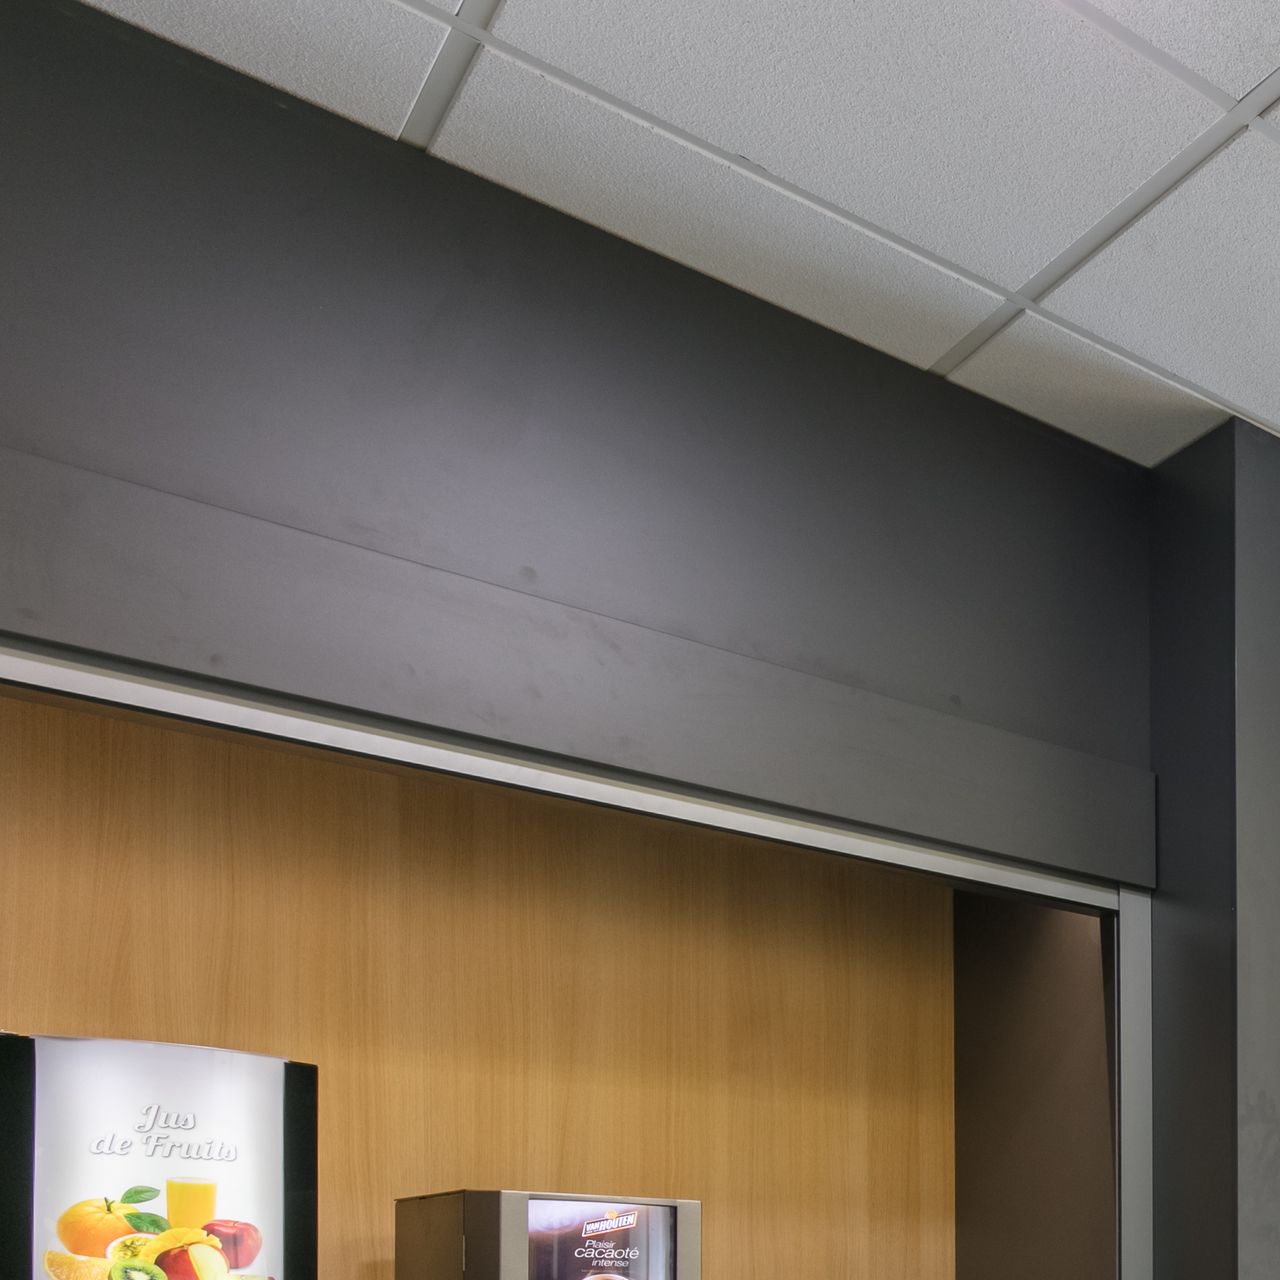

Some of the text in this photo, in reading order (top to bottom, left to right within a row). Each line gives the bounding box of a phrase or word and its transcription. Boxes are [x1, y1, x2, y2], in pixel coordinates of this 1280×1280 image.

[135, 1104, 196, 1133] Jus
[90, 1133, 238, 1161] de Fruits
[585, 1239, 616, 1249] Plaisir
[574, 1247, 640, 1260] cacaoté
[591, 1259, 629, 1268] intense
